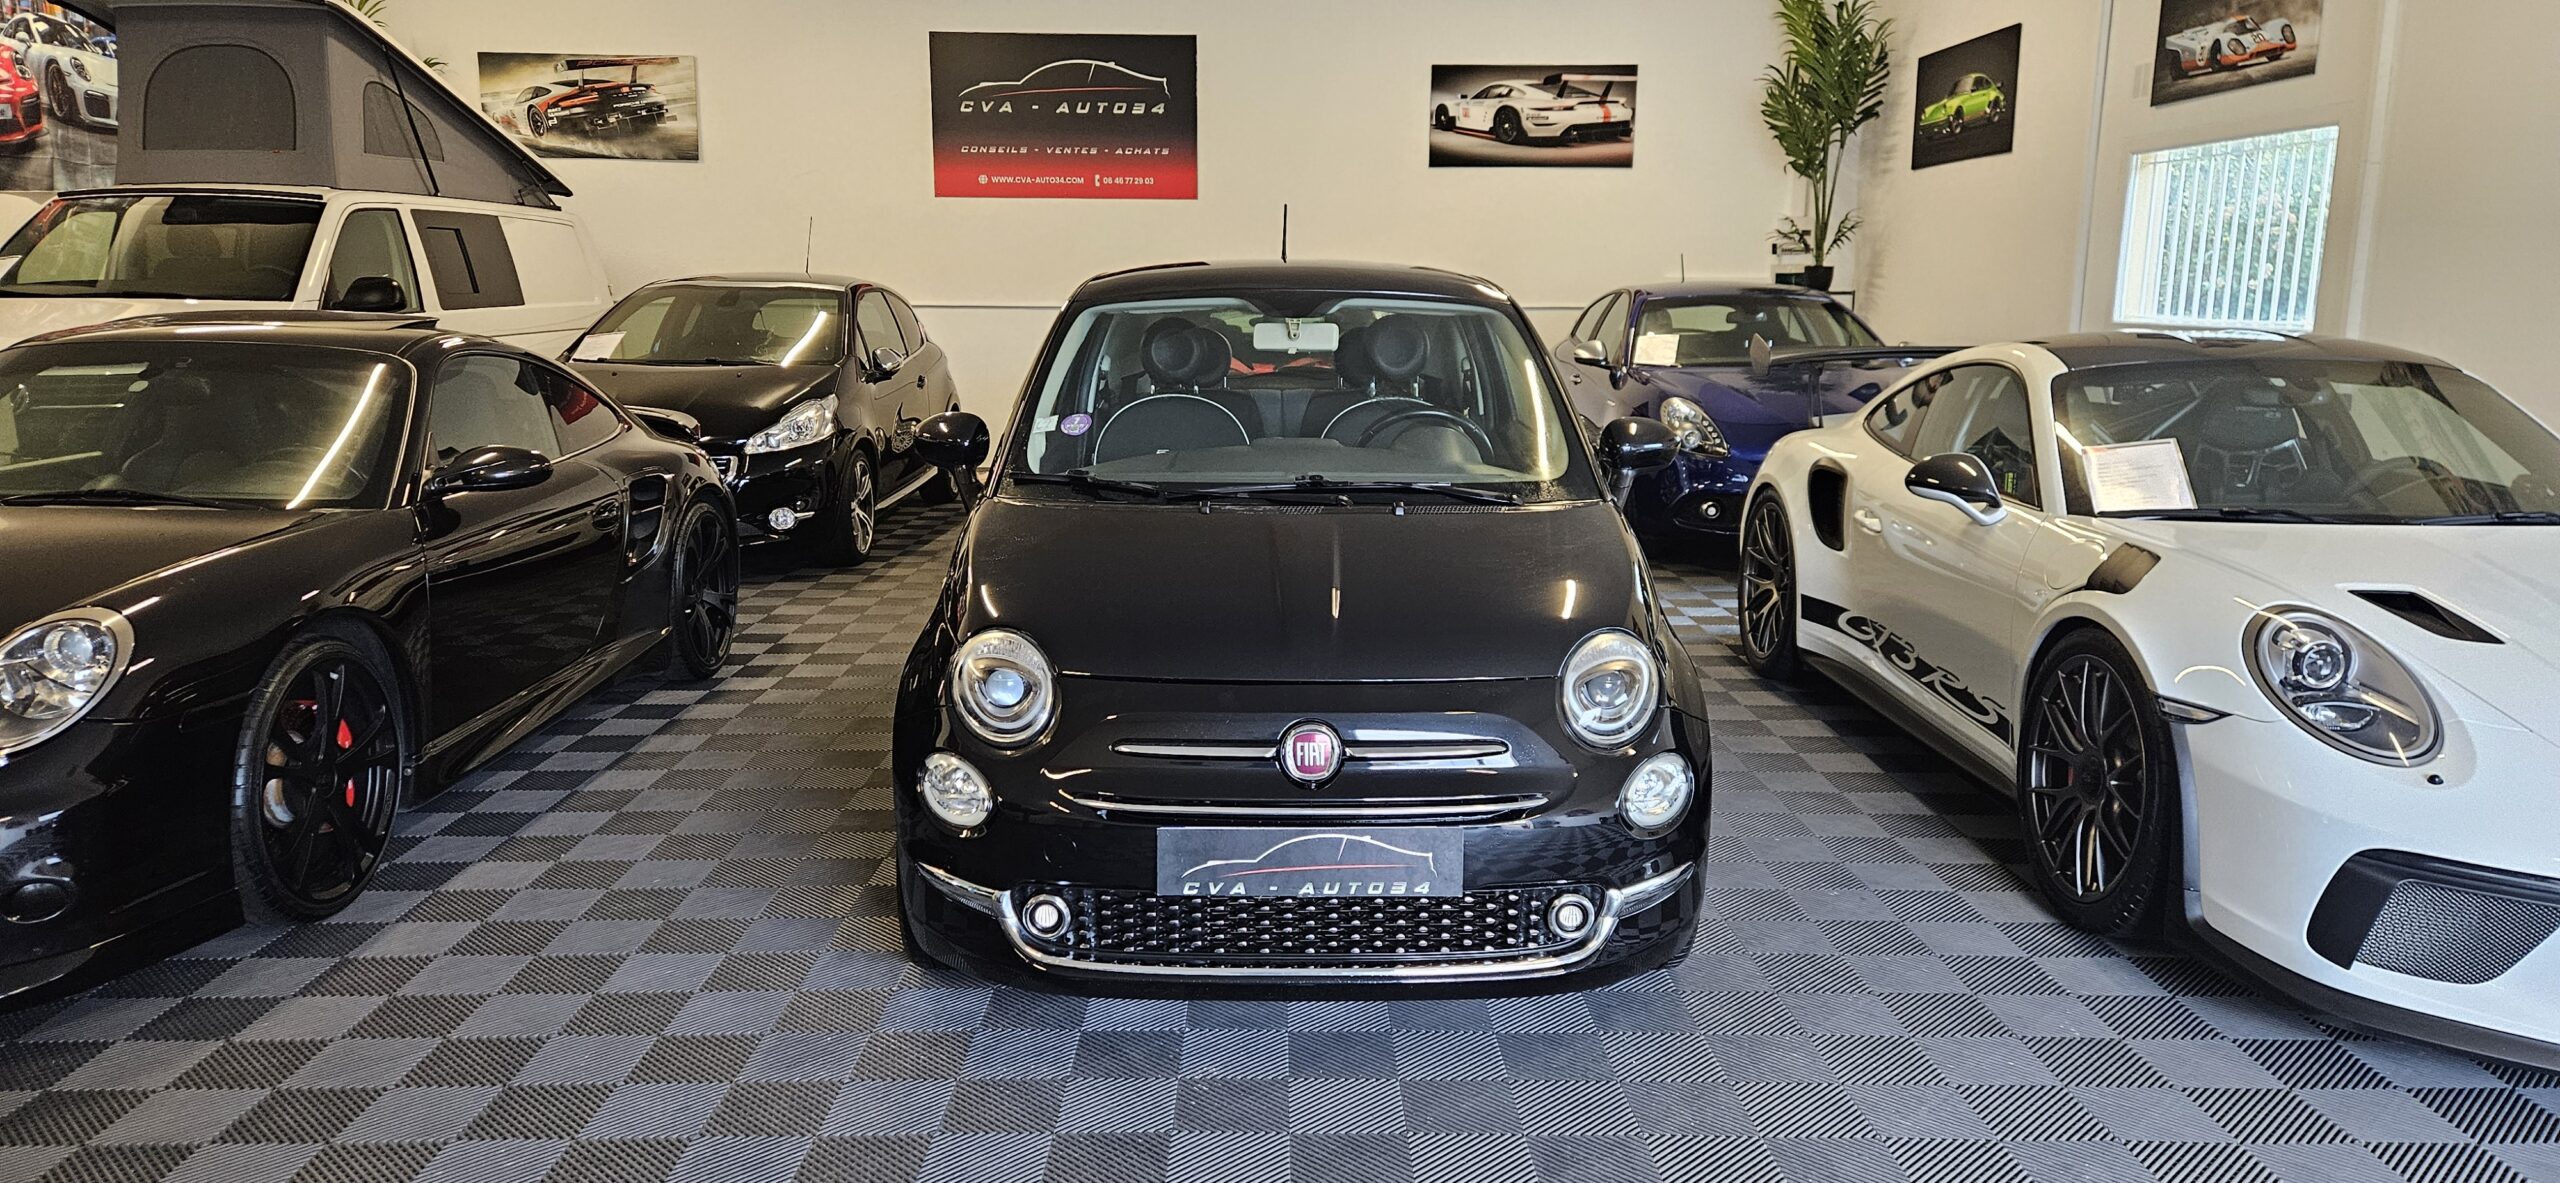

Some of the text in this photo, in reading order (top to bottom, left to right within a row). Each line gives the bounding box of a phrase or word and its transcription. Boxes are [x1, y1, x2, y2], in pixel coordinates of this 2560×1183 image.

[960, 101, 1013, 113] CVA
[1055, 102, 1166, 115] AUTO34
[961, 146, 1028, 154] CONSEILS
[1046, 147, 1098, 155] VENTES
[1115, 147, 1170, 156] ACHATS
[991, 176, 1085, 185] WWW.CVA-AUTO34.COM
[1837, 611, 2006, 725] GT3 RS
[1296, 741, 1327, 767] FIAT
[1182, 881, 1247, 896] CVA
[1298, 881, 1431, 896] AUTO34
